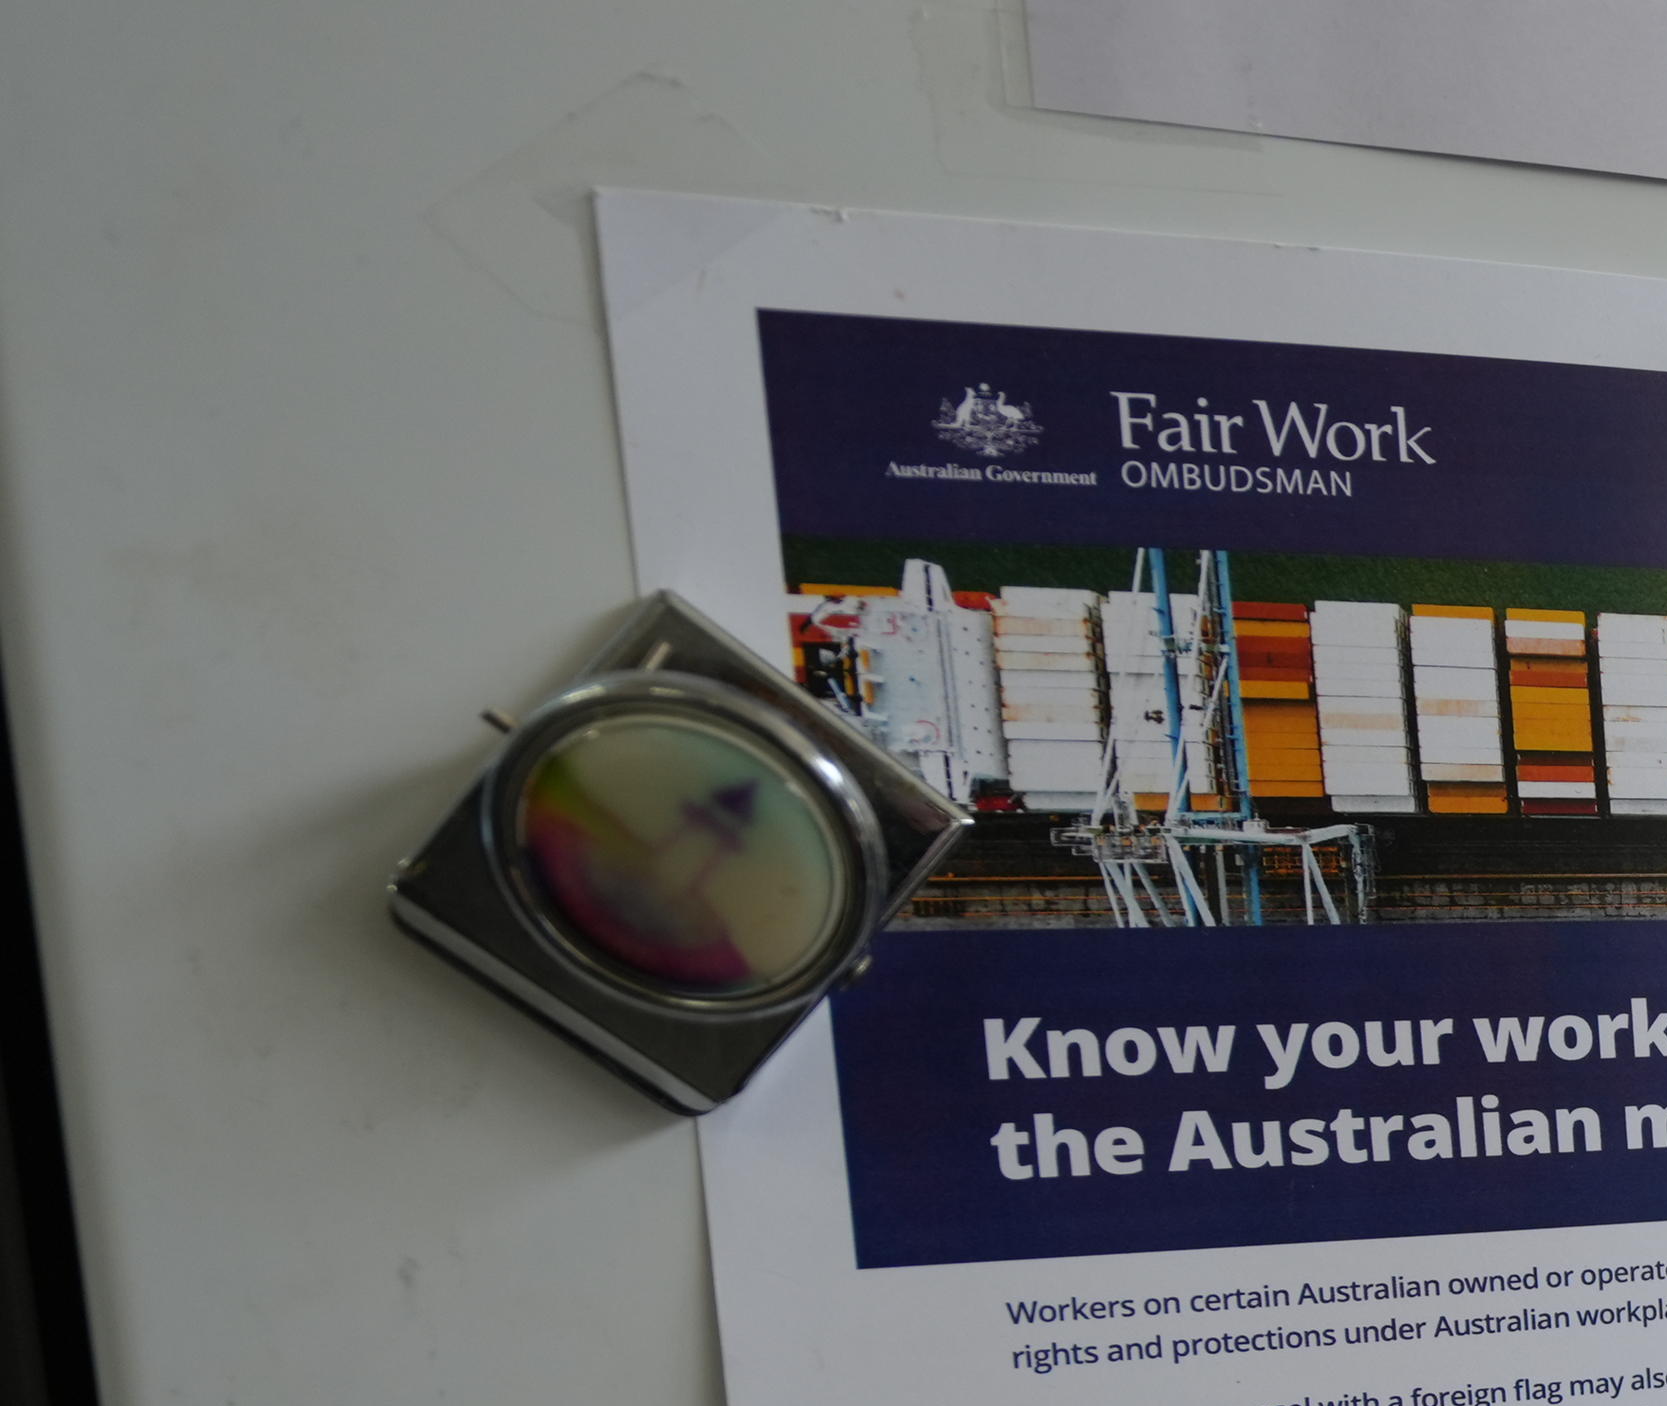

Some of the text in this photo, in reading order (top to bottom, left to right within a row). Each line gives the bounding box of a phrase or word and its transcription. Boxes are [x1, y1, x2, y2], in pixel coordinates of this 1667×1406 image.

[1110, 391, 1436, 465] Fair Work
[886, 461, 1096, 485] Australian Government
[1122, 460, 1351, 496] OMBUDSMAN
[984, 1017, 1235, 1080] Know
[1257, 1019, 1453, 1090] your
[990, 1112, 1144, 1181] the
[1168, 1096, 1602, 1172] Australian
[1006, 1297, 1135, 1325] Workers
[1144, 1296, 1180, 1316] on
[1190, 1285, 1289, 1313] certain
[1298, 1276, 1440, 1306] Australian
[1449, 1266, 1538, 1295] owned
[1546, 1270, 1573, 1288] or
[1013, 1342, 1099, 1375] rights
[1108, 1335, 1162, 1362] and
[1173, 1326, 1336, 1364] protections
[1345, 1318, 1426, 1344] under
[1434, 1308, 1569, 1338] Australian
[1513, 1378, 1563, 1405] flag
[1570, 1376, 1624, 1400] may
